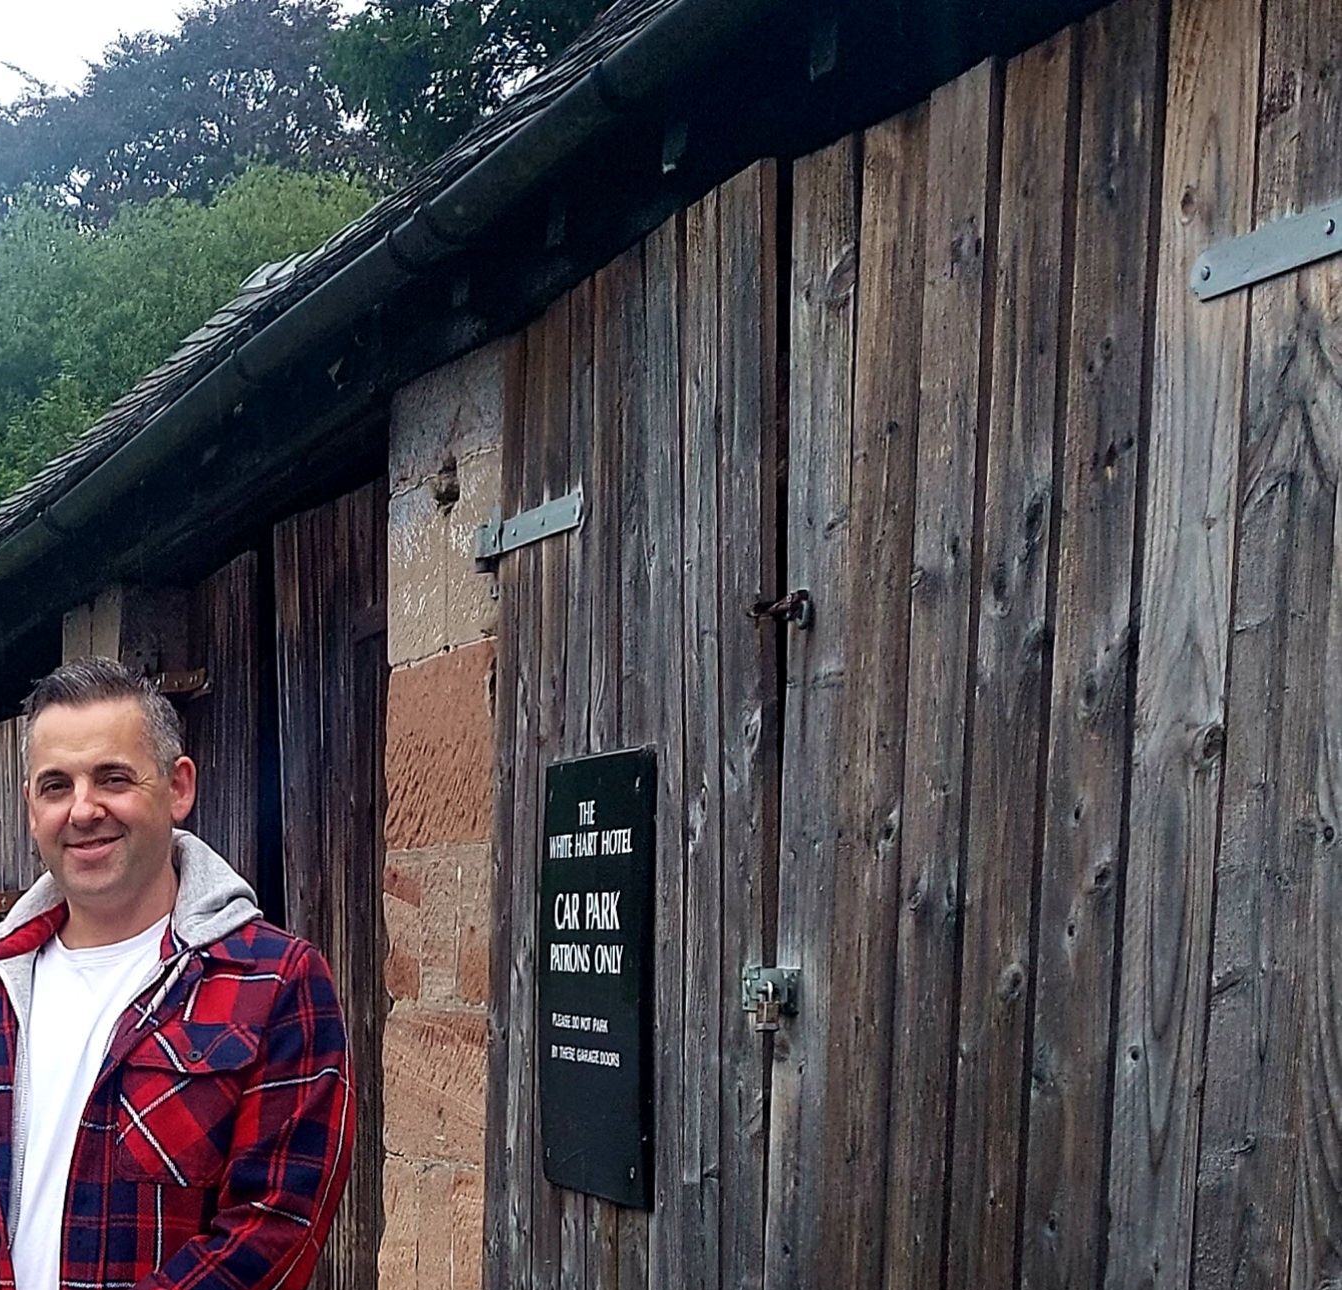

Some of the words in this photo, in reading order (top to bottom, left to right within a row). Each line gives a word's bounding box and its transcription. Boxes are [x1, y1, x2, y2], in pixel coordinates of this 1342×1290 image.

[578, 800, 596, 826] THE
[549, 834, 573, 859] WHITE
[574, 831, 599, 857] HART
[601, 827, 633, 855] HOTEL
[554, 893, 580, 930] CAR
[585, 890, 620, 930] PARK
[550, 942, 590, 973] PATRONS
[594, 944, 623, 974] ONLY
[580, 1016, 591, 1031] NOT
[592, 1017, 608, 1033] PARK
[600, 1050, 620, 1067] DOORS
